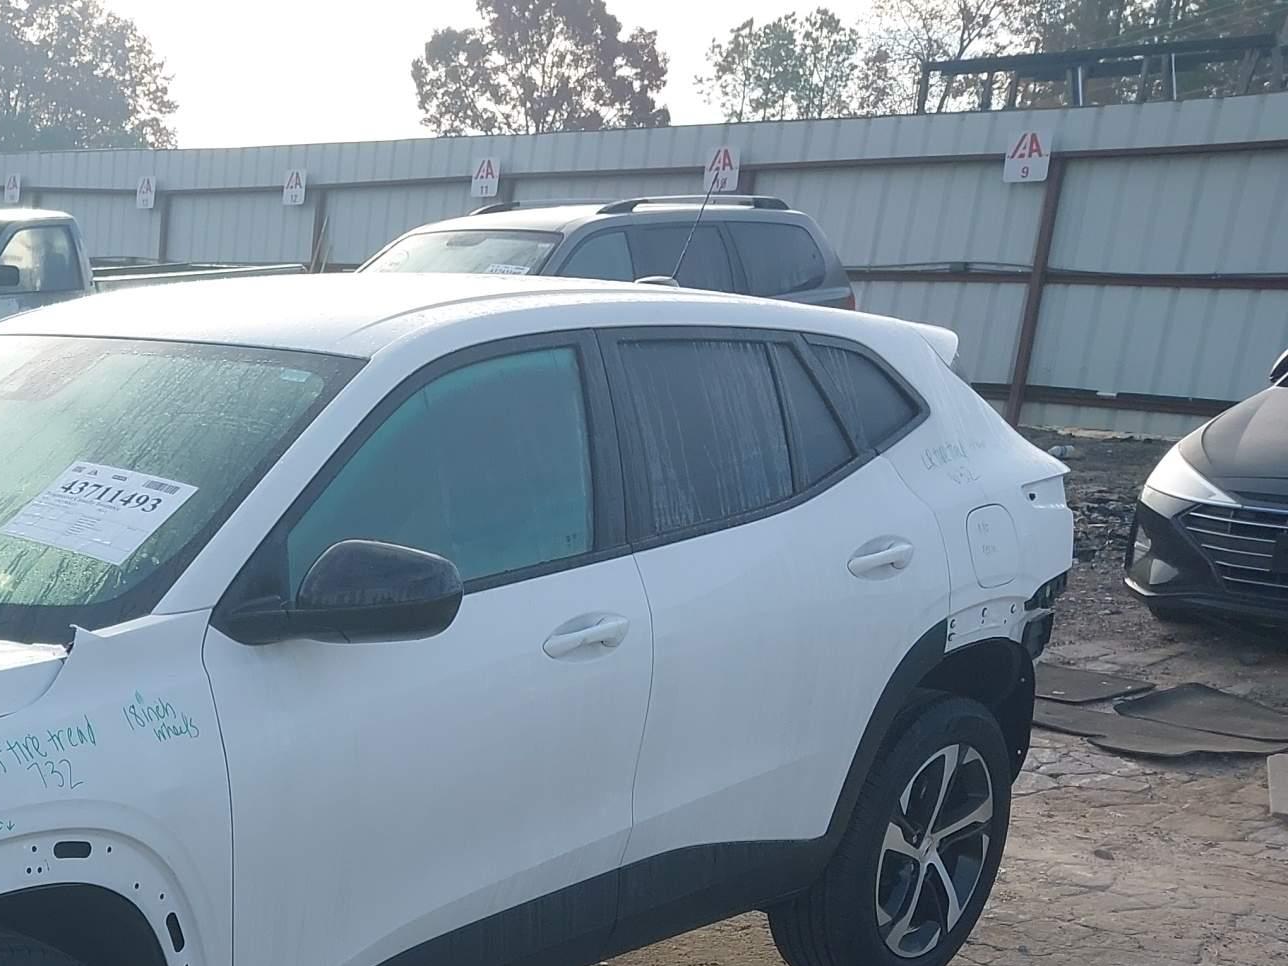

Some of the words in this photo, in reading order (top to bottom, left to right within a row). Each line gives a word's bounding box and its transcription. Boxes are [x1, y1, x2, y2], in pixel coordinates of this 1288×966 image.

[1021, 166, 1029, 178] 9
[480, 185, 489, 196] 11
[60, 479, 163, 513] 43711493
